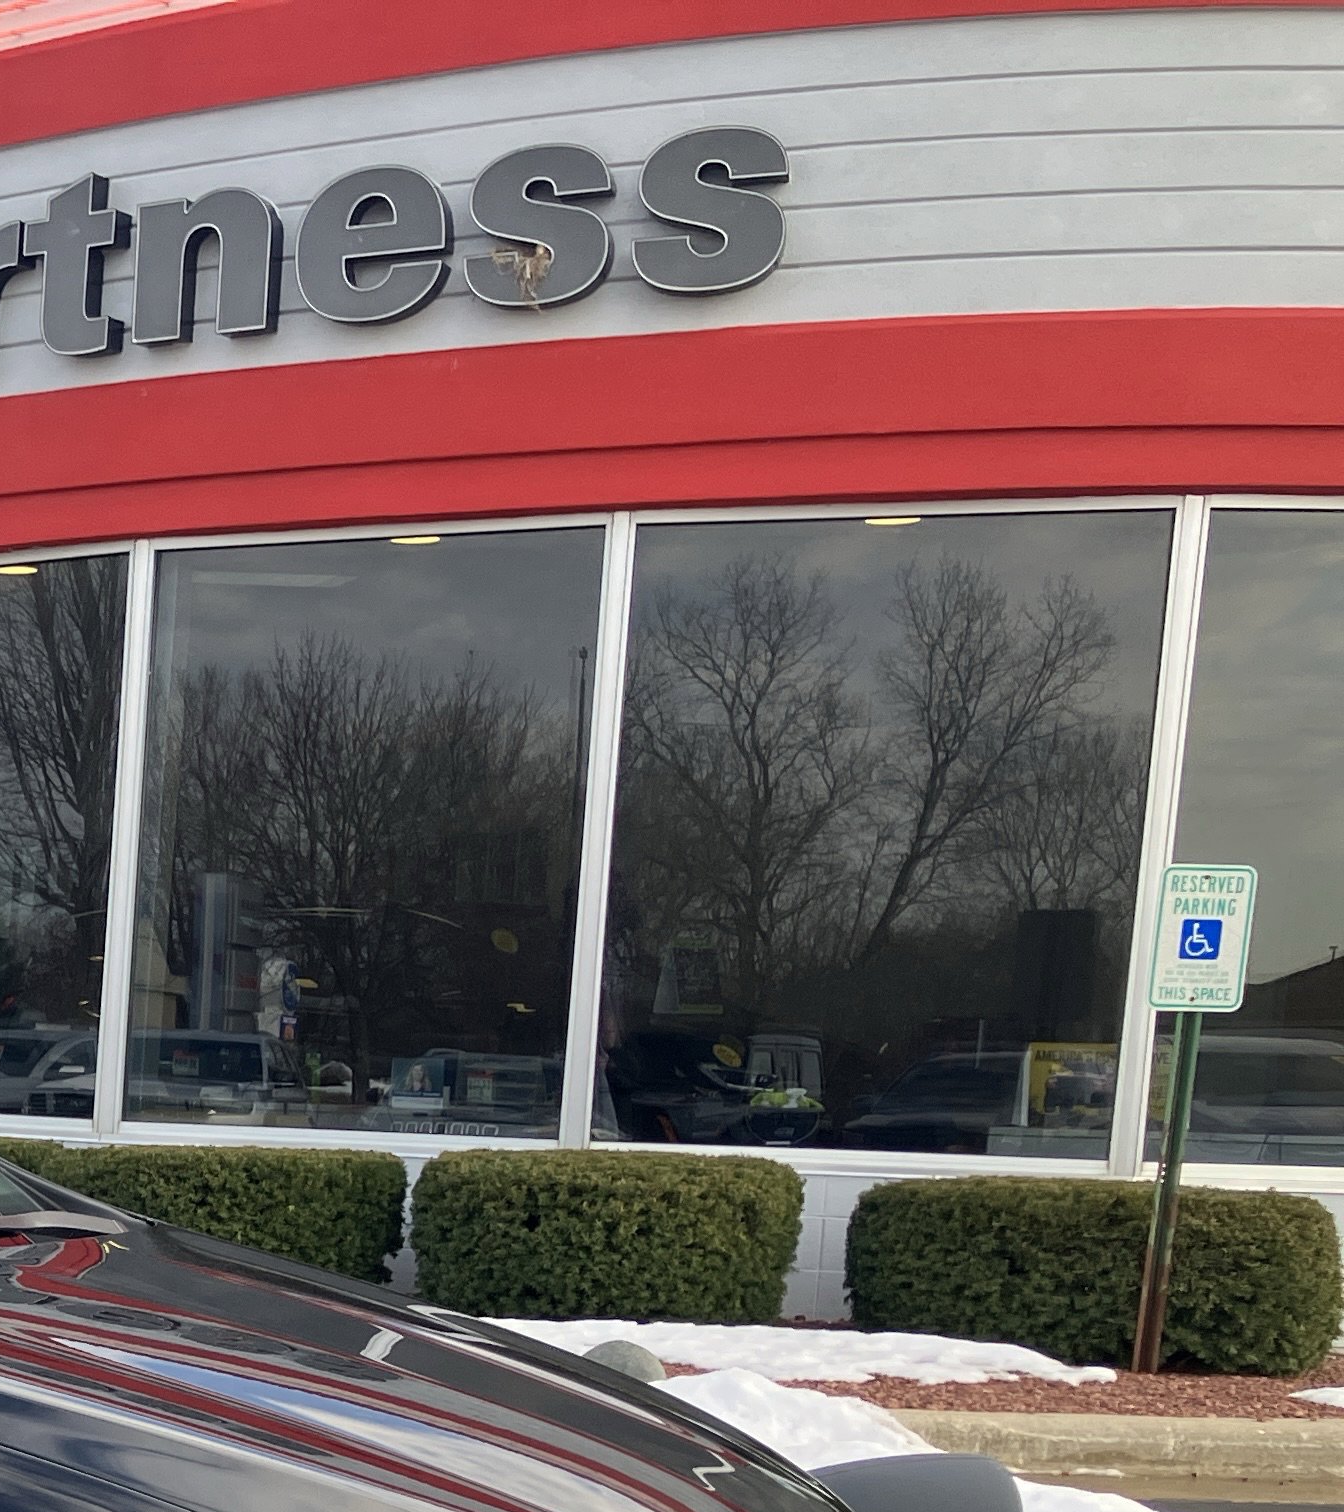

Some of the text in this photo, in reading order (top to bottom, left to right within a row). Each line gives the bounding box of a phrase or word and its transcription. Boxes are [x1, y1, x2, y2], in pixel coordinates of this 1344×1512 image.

[1171, 875, 1244, 893] RESERVED
[1173, 898, 1236, 916] PARKING
[1158, 987, 1232, 1001] THIS SPACE
